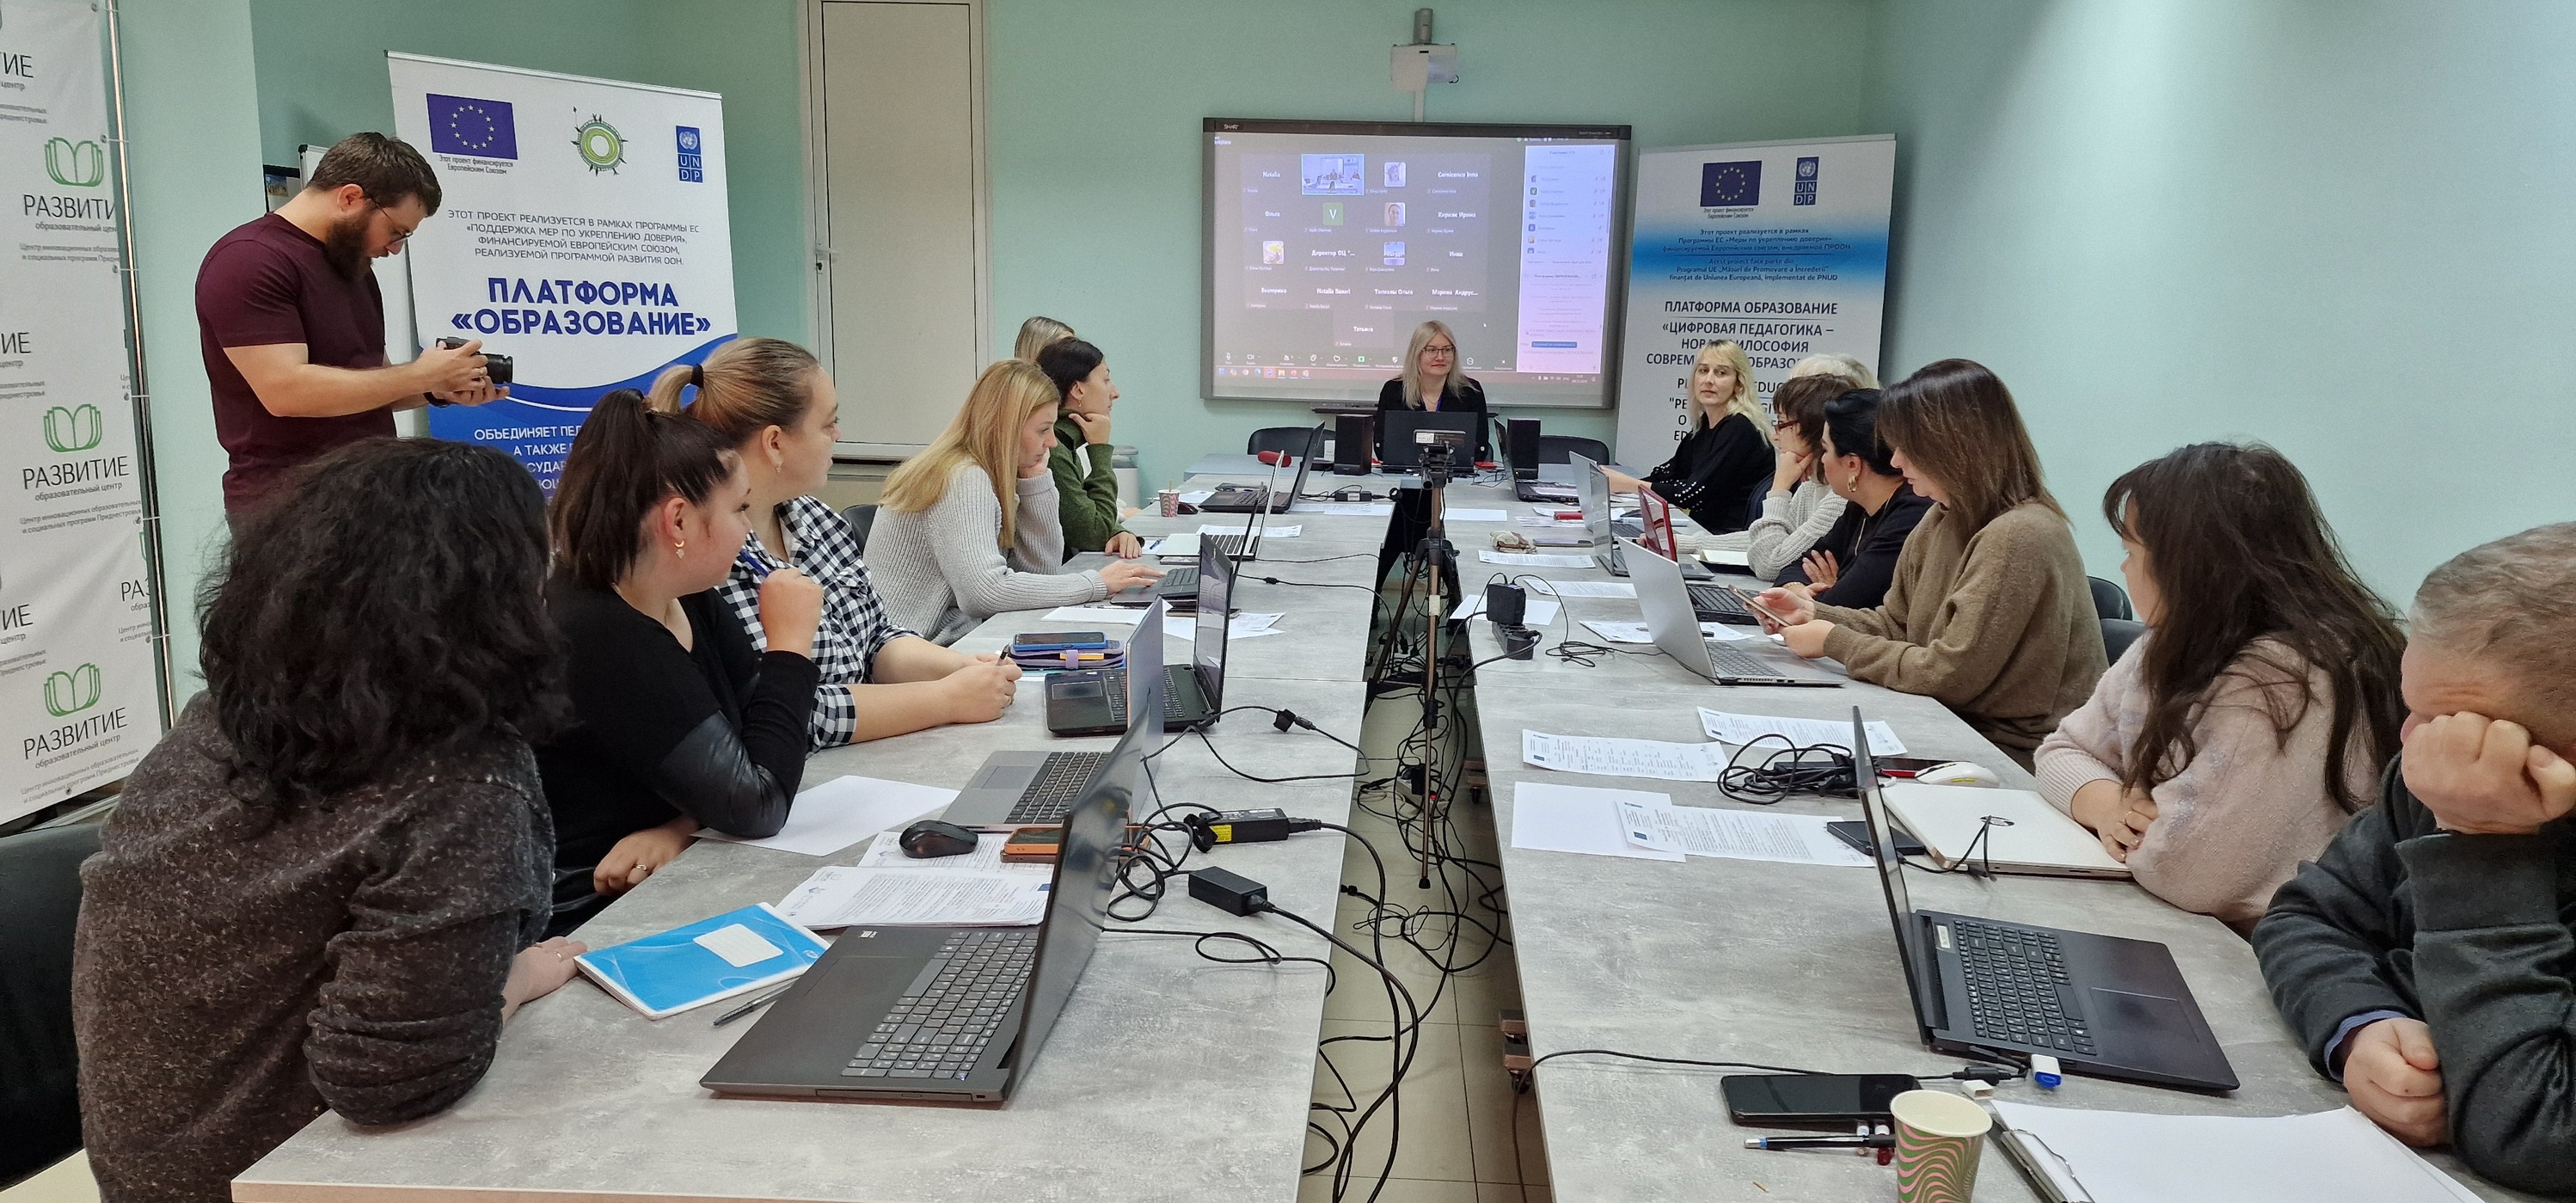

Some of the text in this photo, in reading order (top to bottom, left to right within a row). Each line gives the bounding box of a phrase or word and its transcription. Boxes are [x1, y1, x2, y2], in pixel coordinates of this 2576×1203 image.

[23, 193, 117, 220] РАЗВИТИ
[448, 210, 474, 219] ЭТОТ
[477, 212, 516, 222] ПРОЕКТ
[519, 214, 586, 226] РЕАЛИЗУЕТСЯ
[597, 219, 633, 229] РАМКАХ
[635, 221, 687, 232] ПРОГРАММЫ
[467, 224, 537, 235] «ПОДДЕРЖКА
[538, 228, 559, 236] МЕР
[579, 230, 641, 241] УКРЕПЛЕНИЮ
[643, 233, 688, 244] ДОВЕРИЯ»,
[478, 236, 679, 255] ФИНАНСИРУЕМОЙ ЕВРОПЕЙСКИМ СОЮЗОМ,
[475, 248, 684, 265] РЕАЛИЗУЕМОЙ ПРОГРАММОЙ РАЗВИТИЯ ООН.
[1764, 273, 1806, 282] implementat
[488, 278, 679, 307] ПЛАТФОРМА
[1665, 301, 1837, 315] ПЛАТФОРМА ОБРАЗОВАНИЕ
[451, 308, 711, 335] «ОБРАЗОВАНИЕ»
[1662, 322, 1736, 336] «ЦИФРОВАЯ
[1740, 322, 1823, 339] ПЕДАГОГИКА
[1737, 339, 1809, 353] ИЛОСОФИЯ
[1647, 353, 1696, 365] СОВРЕМ
[475, 427, 557, 441] ОБЪЕДИНЯЕТ
[513, 444, 567, 457] А ТАКЖЕ
[22, 456, 130, 490] РАЗВИТИЕ
[34, 482, 123, 501] образовательный центр
[23, 707, 128, 760] РАЗВИТИЕ
[35, 734, 121, 769] образовательный центр
